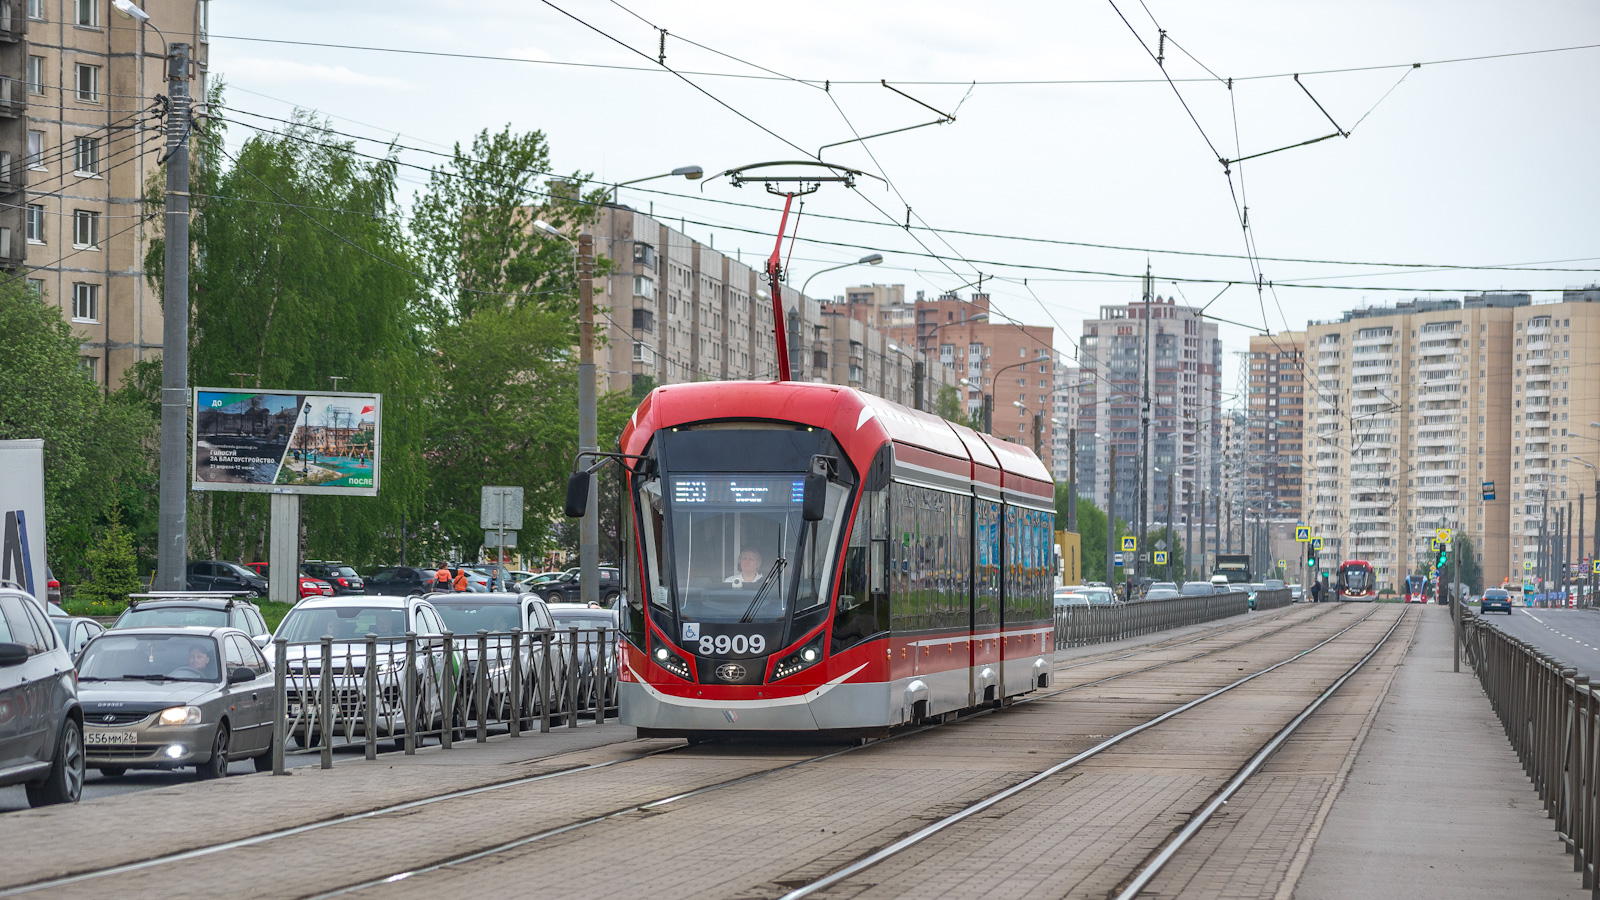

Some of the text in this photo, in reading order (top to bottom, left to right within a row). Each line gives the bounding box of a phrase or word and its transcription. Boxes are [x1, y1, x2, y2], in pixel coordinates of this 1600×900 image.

[211, 399, 223, 407] ДО
[219, 456, 275, 464] БЛАГОУСТРОЙСТВО
[348, 477, 373, 486] ПОСЛЕ
[699, 634, 766, 655] 8909
[123, 732, 134, 741] 26
